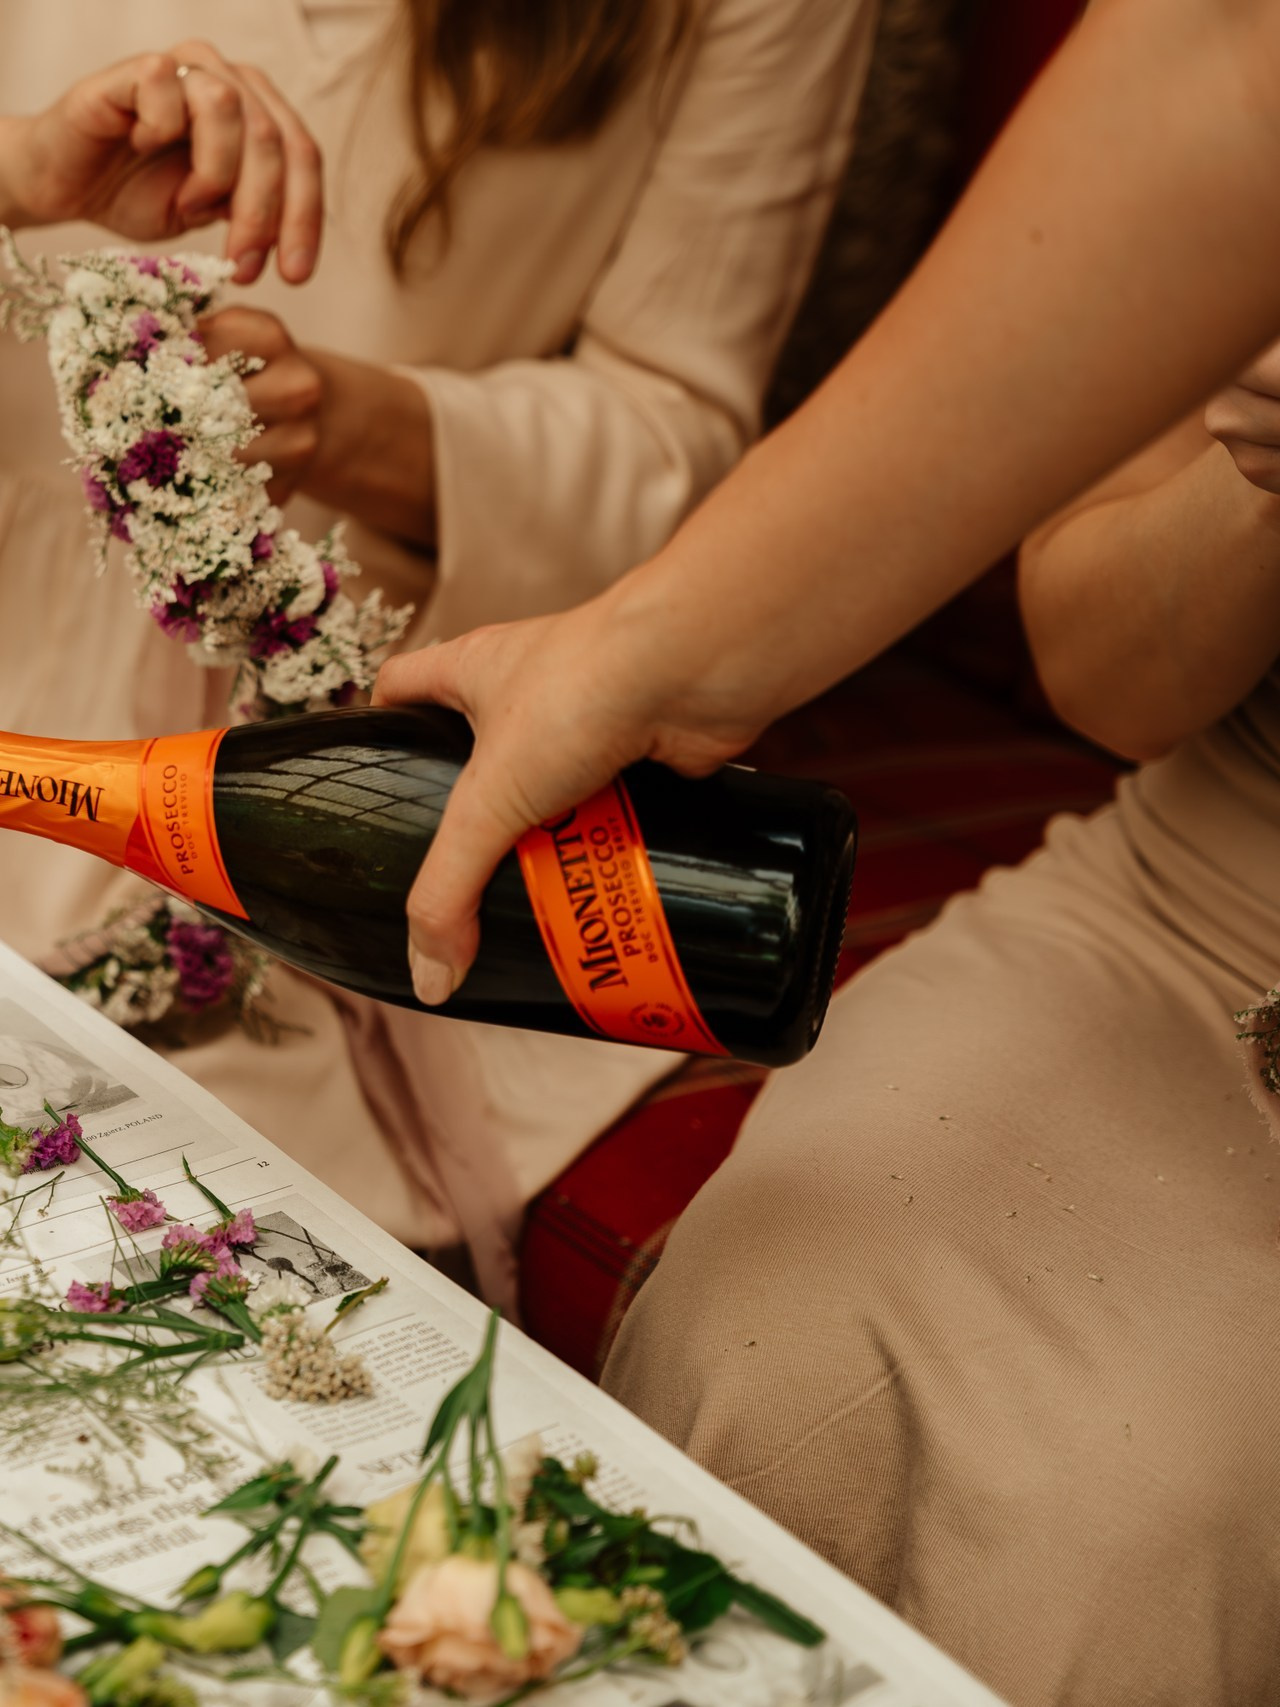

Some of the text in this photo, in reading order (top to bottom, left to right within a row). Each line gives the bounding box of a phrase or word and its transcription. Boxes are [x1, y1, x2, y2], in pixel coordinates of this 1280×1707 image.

[162, 764, 195, 875] PROSECCO
[180, 773, 190, 826] TREVISO
[589, 826, 642, 958] PROSECCO
[125, 1113, 164, 1130] POLAND
[256, 1160, 271, 1170] 12
